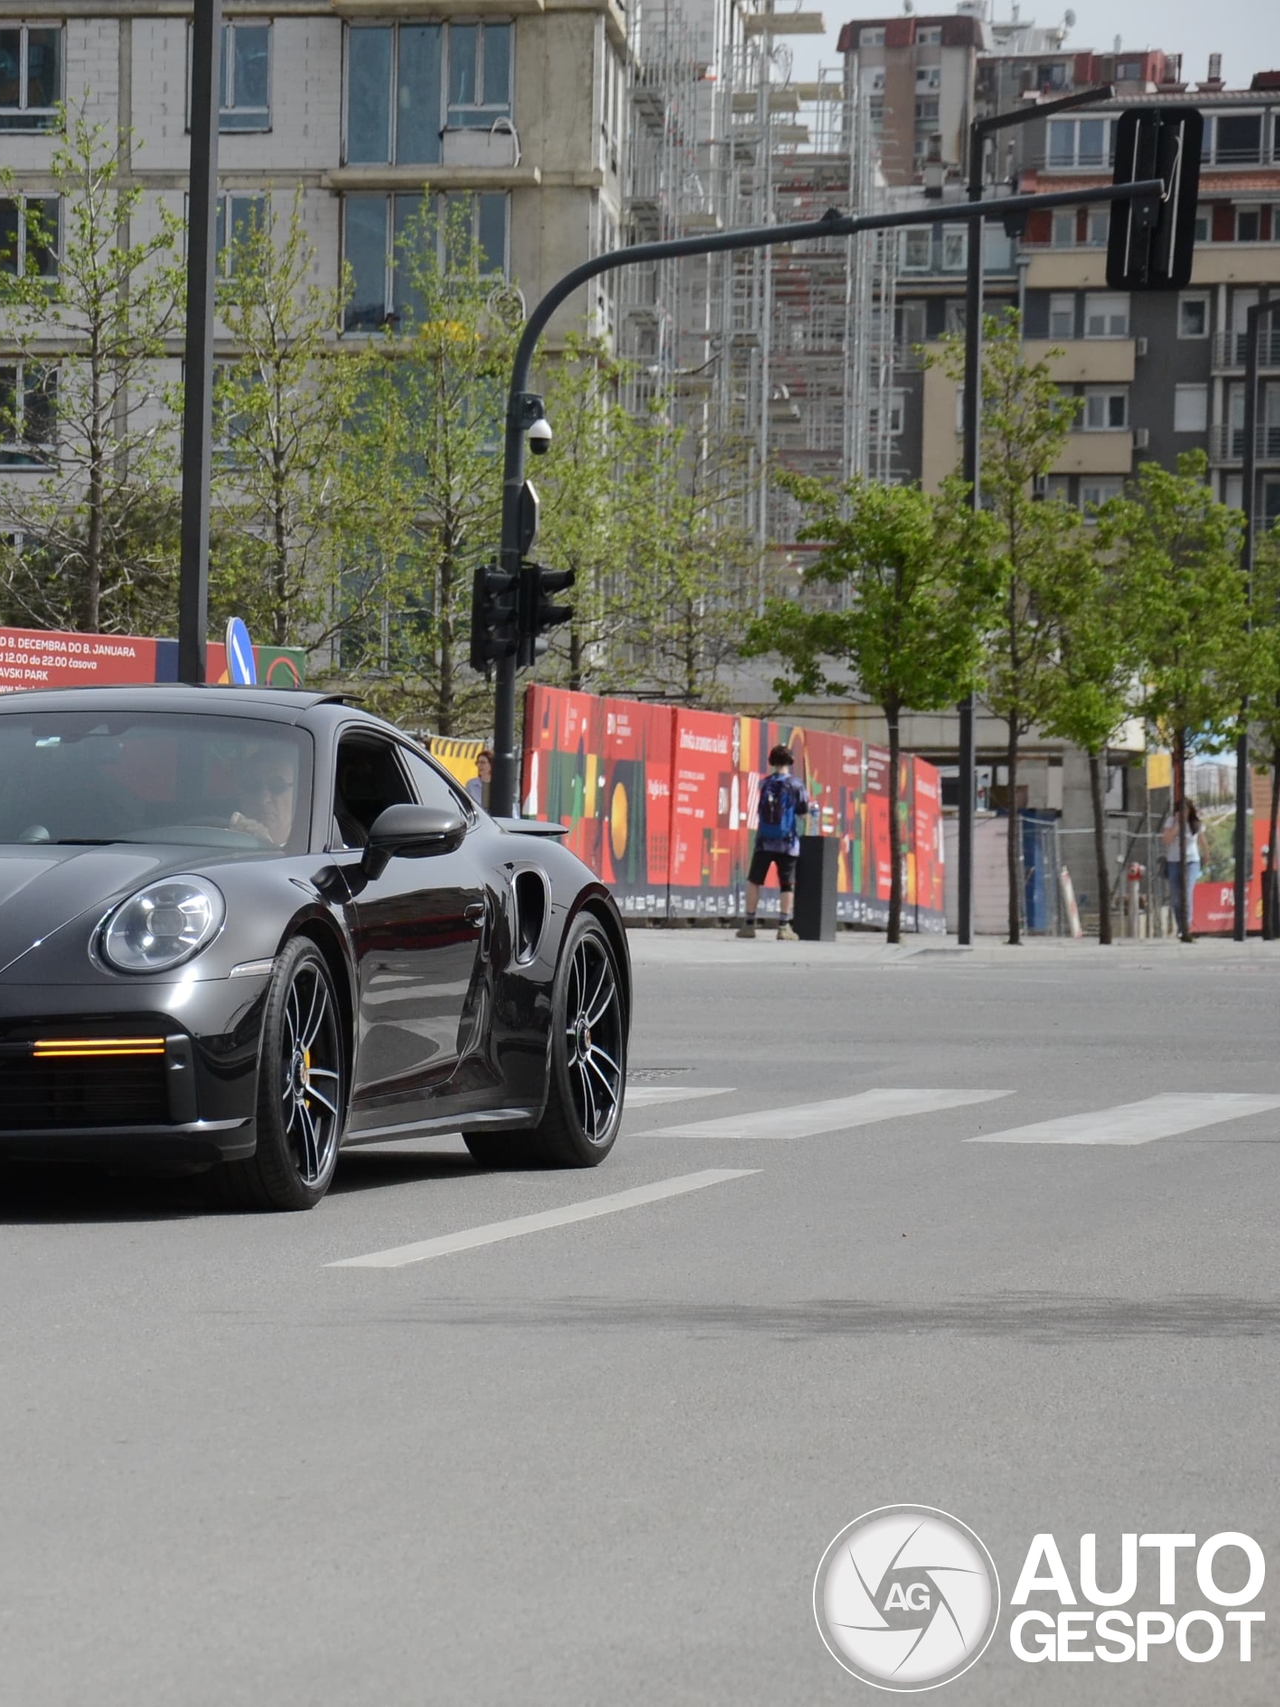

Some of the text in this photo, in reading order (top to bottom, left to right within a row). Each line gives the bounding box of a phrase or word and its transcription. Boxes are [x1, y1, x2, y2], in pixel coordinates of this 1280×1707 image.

[8, 637, 16, 648] 8.
[18, 637, 67, 652] DECEMBRA
[68, 642, 82, 654] DO
[83, 643, 91, 654] 8.
[92, 645, 136, 658] JANUARA
[5, 653, 28, 665] 12.00
[29, 654, 40, 665] do
[41, 655, 67, 668] 22.00
[68, 656, 97, 670] časova
[24, 669, 48, 681] PARK
